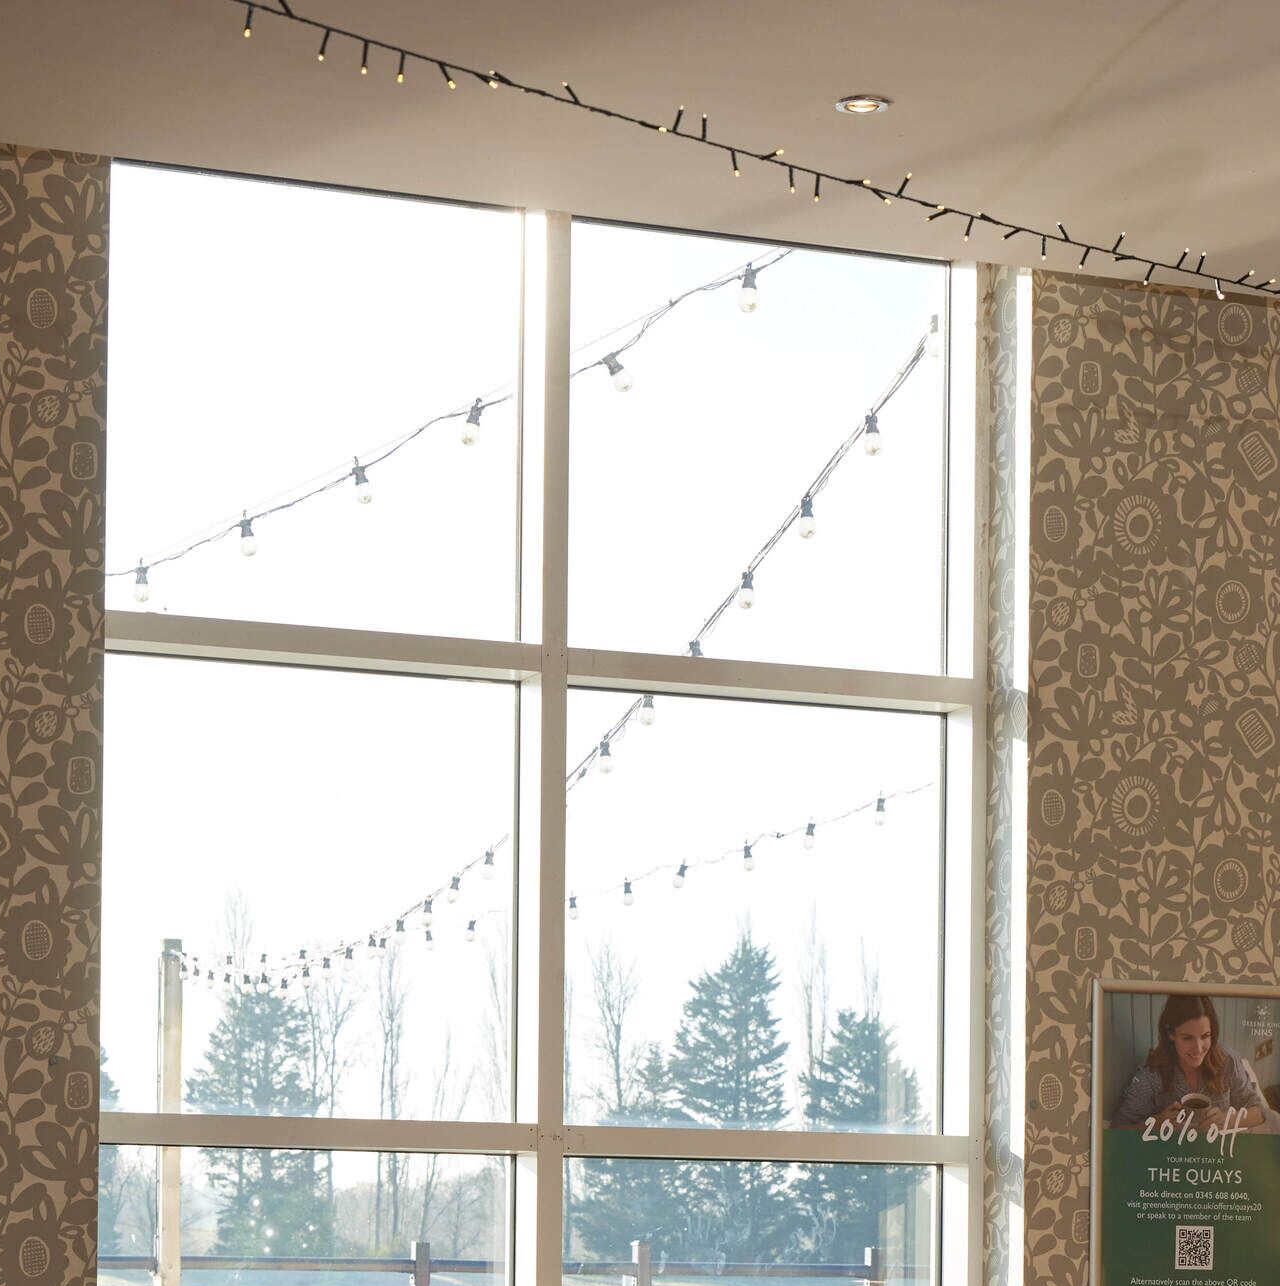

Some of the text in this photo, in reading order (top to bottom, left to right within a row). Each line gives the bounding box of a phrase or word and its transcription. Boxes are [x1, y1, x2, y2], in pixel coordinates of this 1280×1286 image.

[1250, 1028, 1273, 1037] INNS
[1141, 1106, 1249, 1158] 20% off
[1147, 1167, 1243, 1186] THE QUAYS
[1139, 1189, 1159, 1199] Book
[1160, 1190, 1182, 1199] direct
[1195, 1191, 1213, 1200] 0345
[1215, 1191, 1229, 1200] 608
[1230, 1192, 1250, 1201] 6040,
[1147, 1212, 1168, 1221] speak
[1183, 1212, 1212, 1221] member
[1213, 1212, 1221, 1221] of
[1222, 1213, 1234, 1221] the
[1191, 1278, 1203, 1286] the
[1204, 1278, 1225, 1286] above
[1240, 1279, 1257, 1286] code
